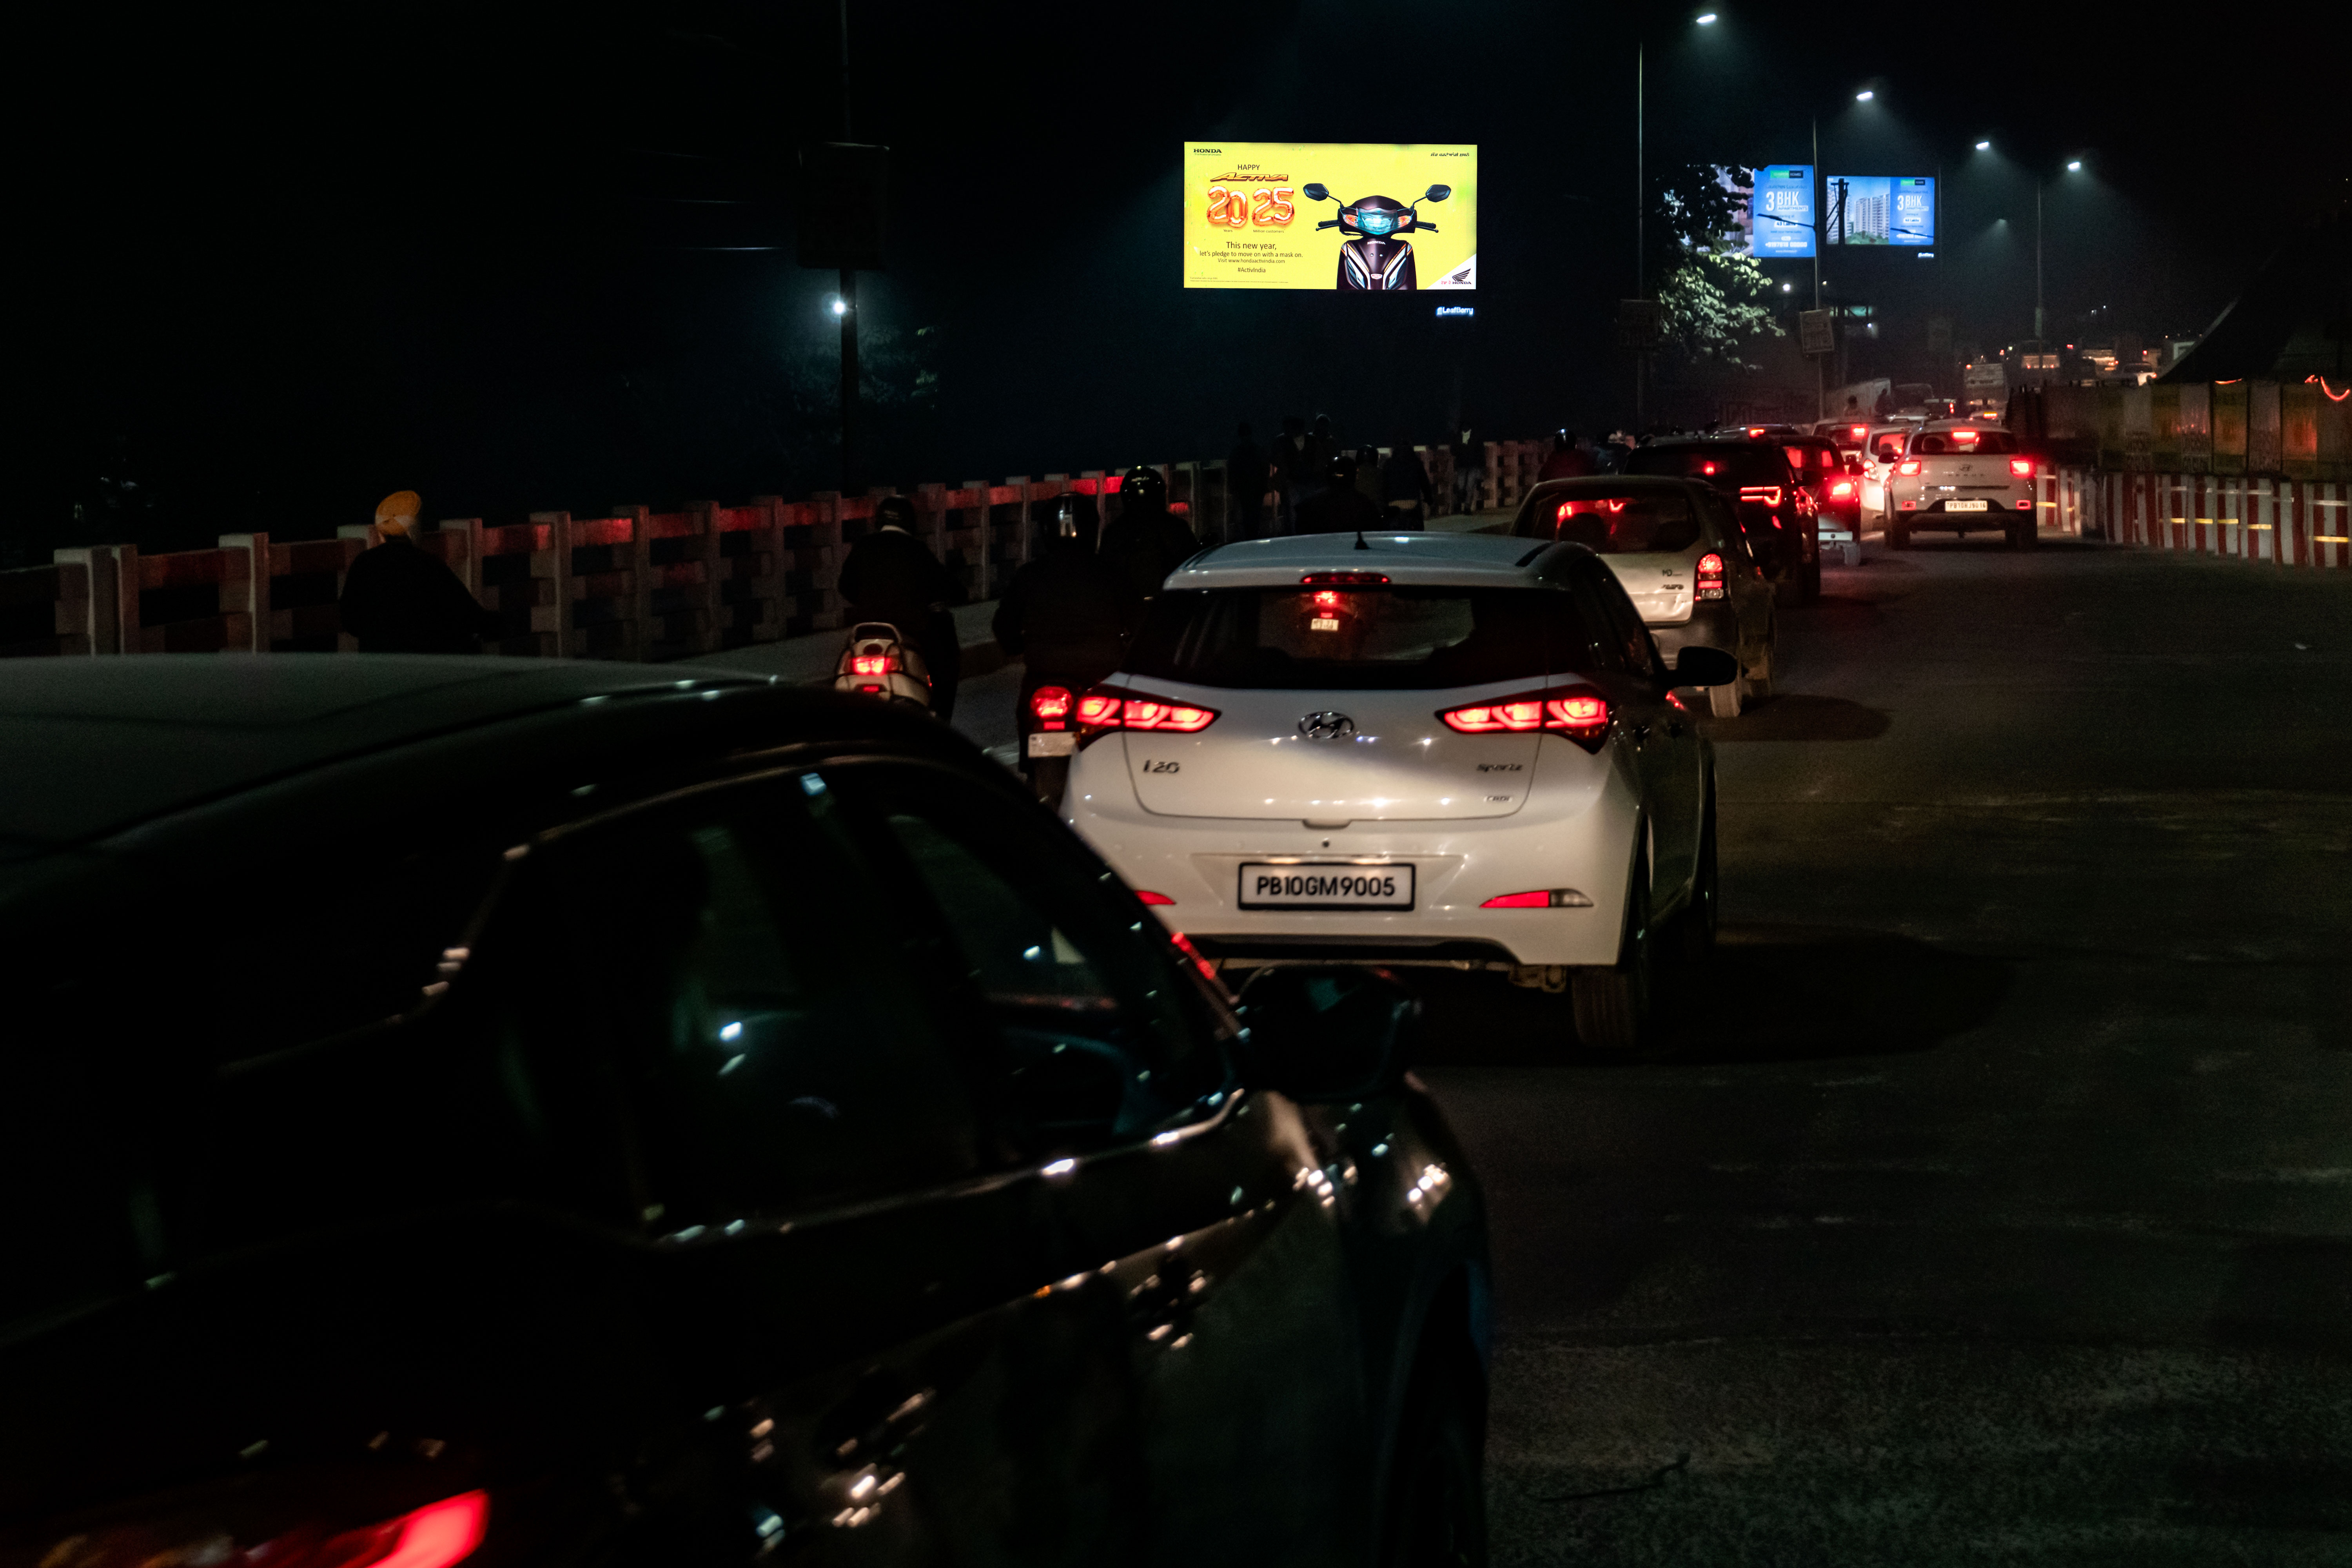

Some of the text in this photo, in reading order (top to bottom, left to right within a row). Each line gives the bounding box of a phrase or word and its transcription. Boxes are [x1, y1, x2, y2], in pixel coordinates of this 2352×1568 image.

[1210, 172, 1289, 181] ACTIVA
[1766, 191, 1799, 211] 3 BHK
[1897, 195, 1922, 211] 3 BHK
[1256, 876, 1396, 896] PB10GM9005
